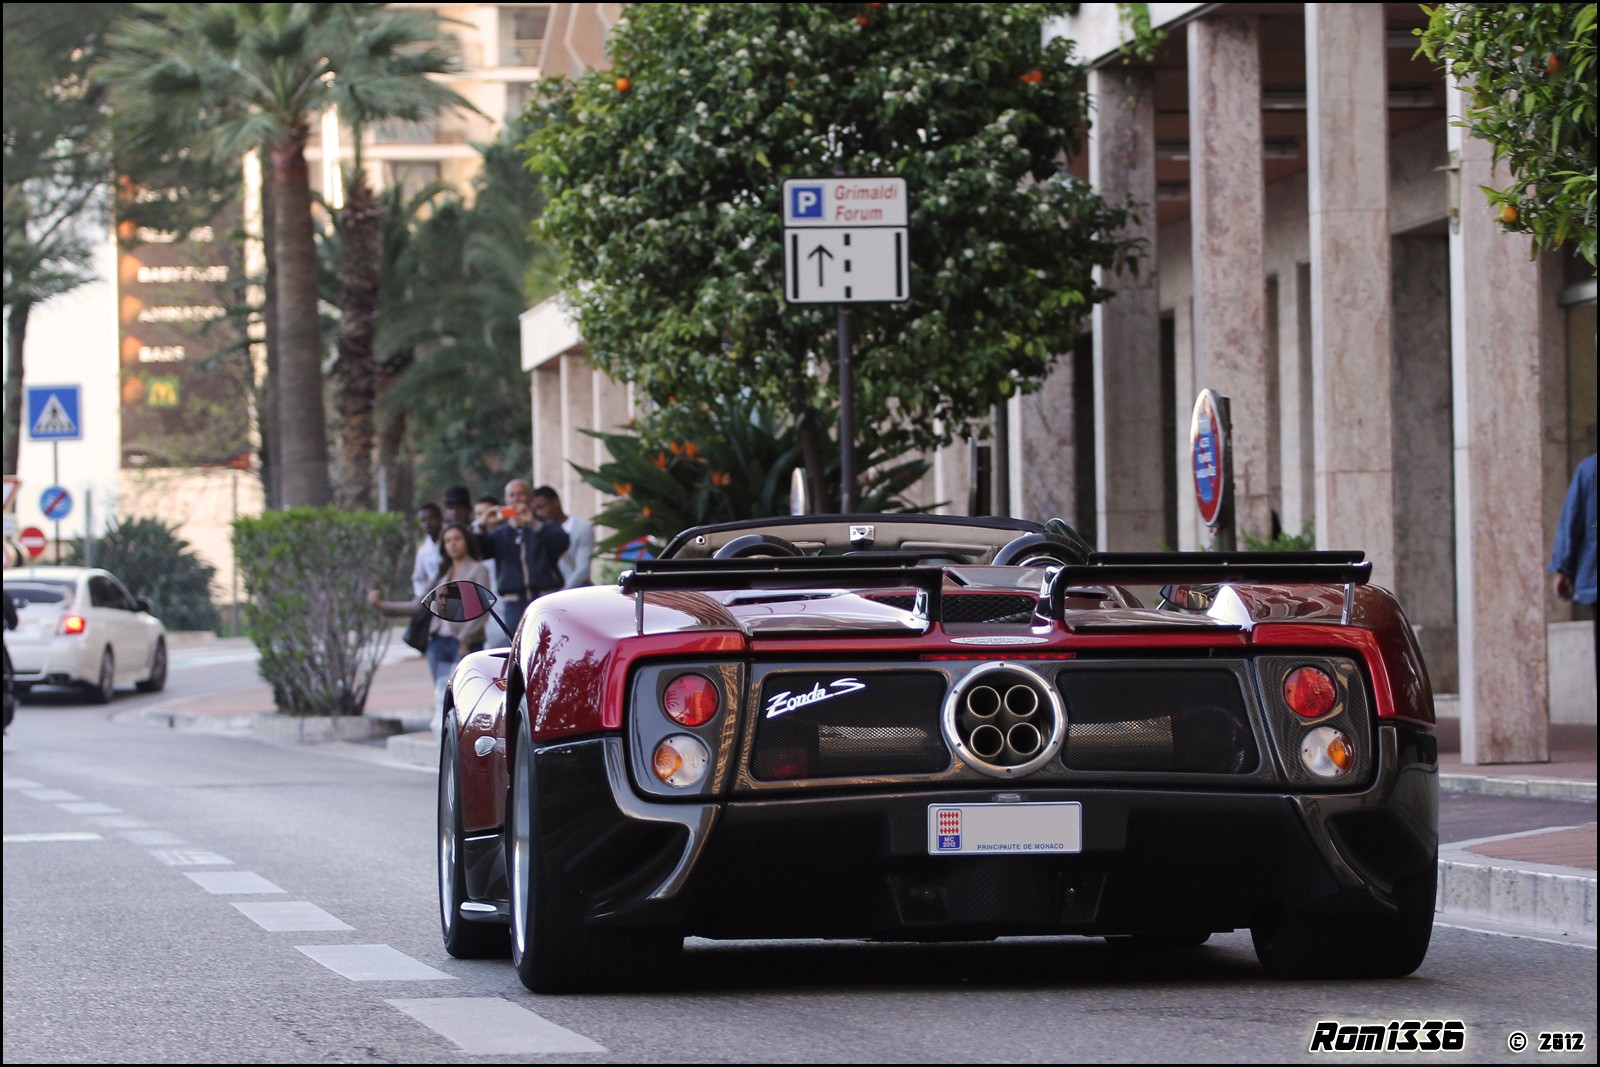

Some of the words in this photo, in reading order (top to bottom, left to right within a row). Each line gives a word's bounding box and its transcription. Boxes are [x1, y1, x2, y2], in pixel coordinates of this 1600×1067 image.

[834, 184, 898, 200] Grimaldi
[798, 190, 817, 214] P
[835, 205, 883, 220] Forum
[964, 636, 1035, 645] PAGANI
[766, 681, 828, 718] Zonda
[829, 677, 866, 696] S
[1034, 842, 1064, 850] MONACO
